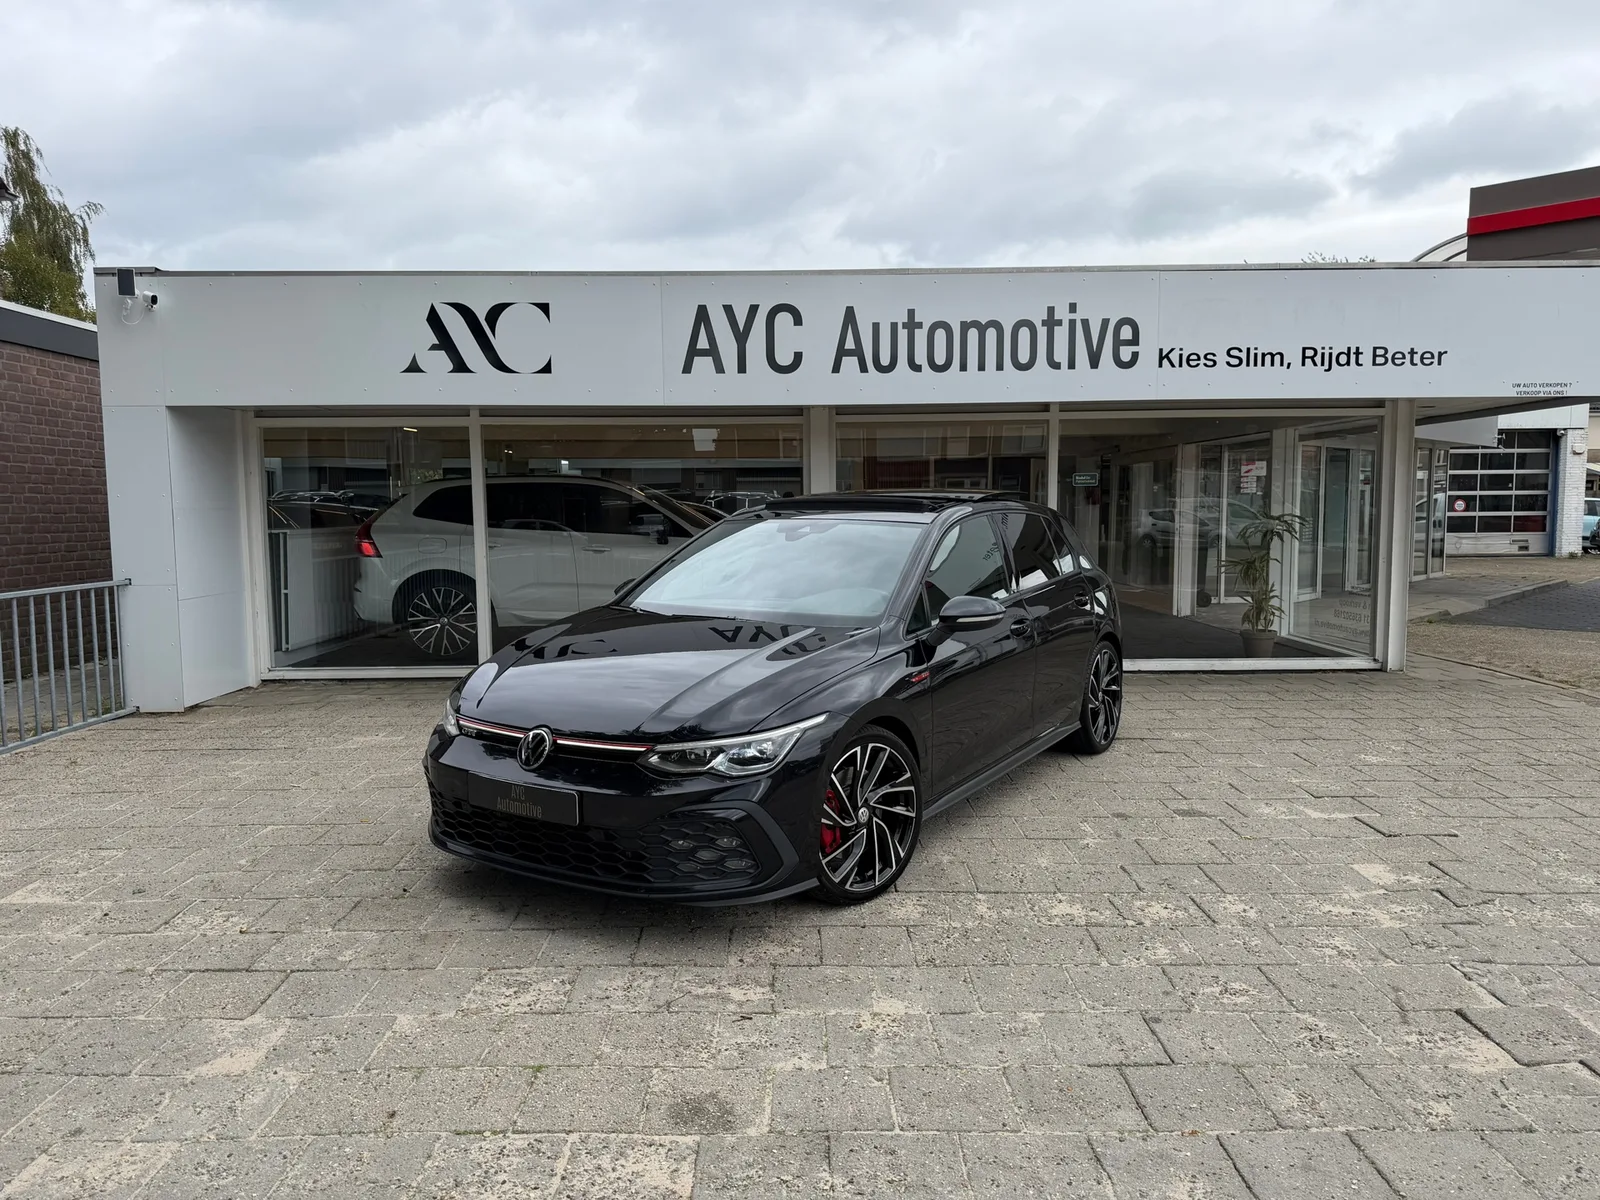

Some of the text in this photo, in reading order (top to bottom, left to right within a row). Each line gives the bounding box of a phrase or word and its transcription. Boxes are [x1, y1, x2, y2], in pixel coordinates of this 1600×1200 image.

[682, 302, 1140, 375] AYC Automotive
[1158, 345, 1449, 373] Kies Slim, Rijdt Beter
[511, 785, 525, 800] AYC
[497, 796, 542, 818] Automotive
